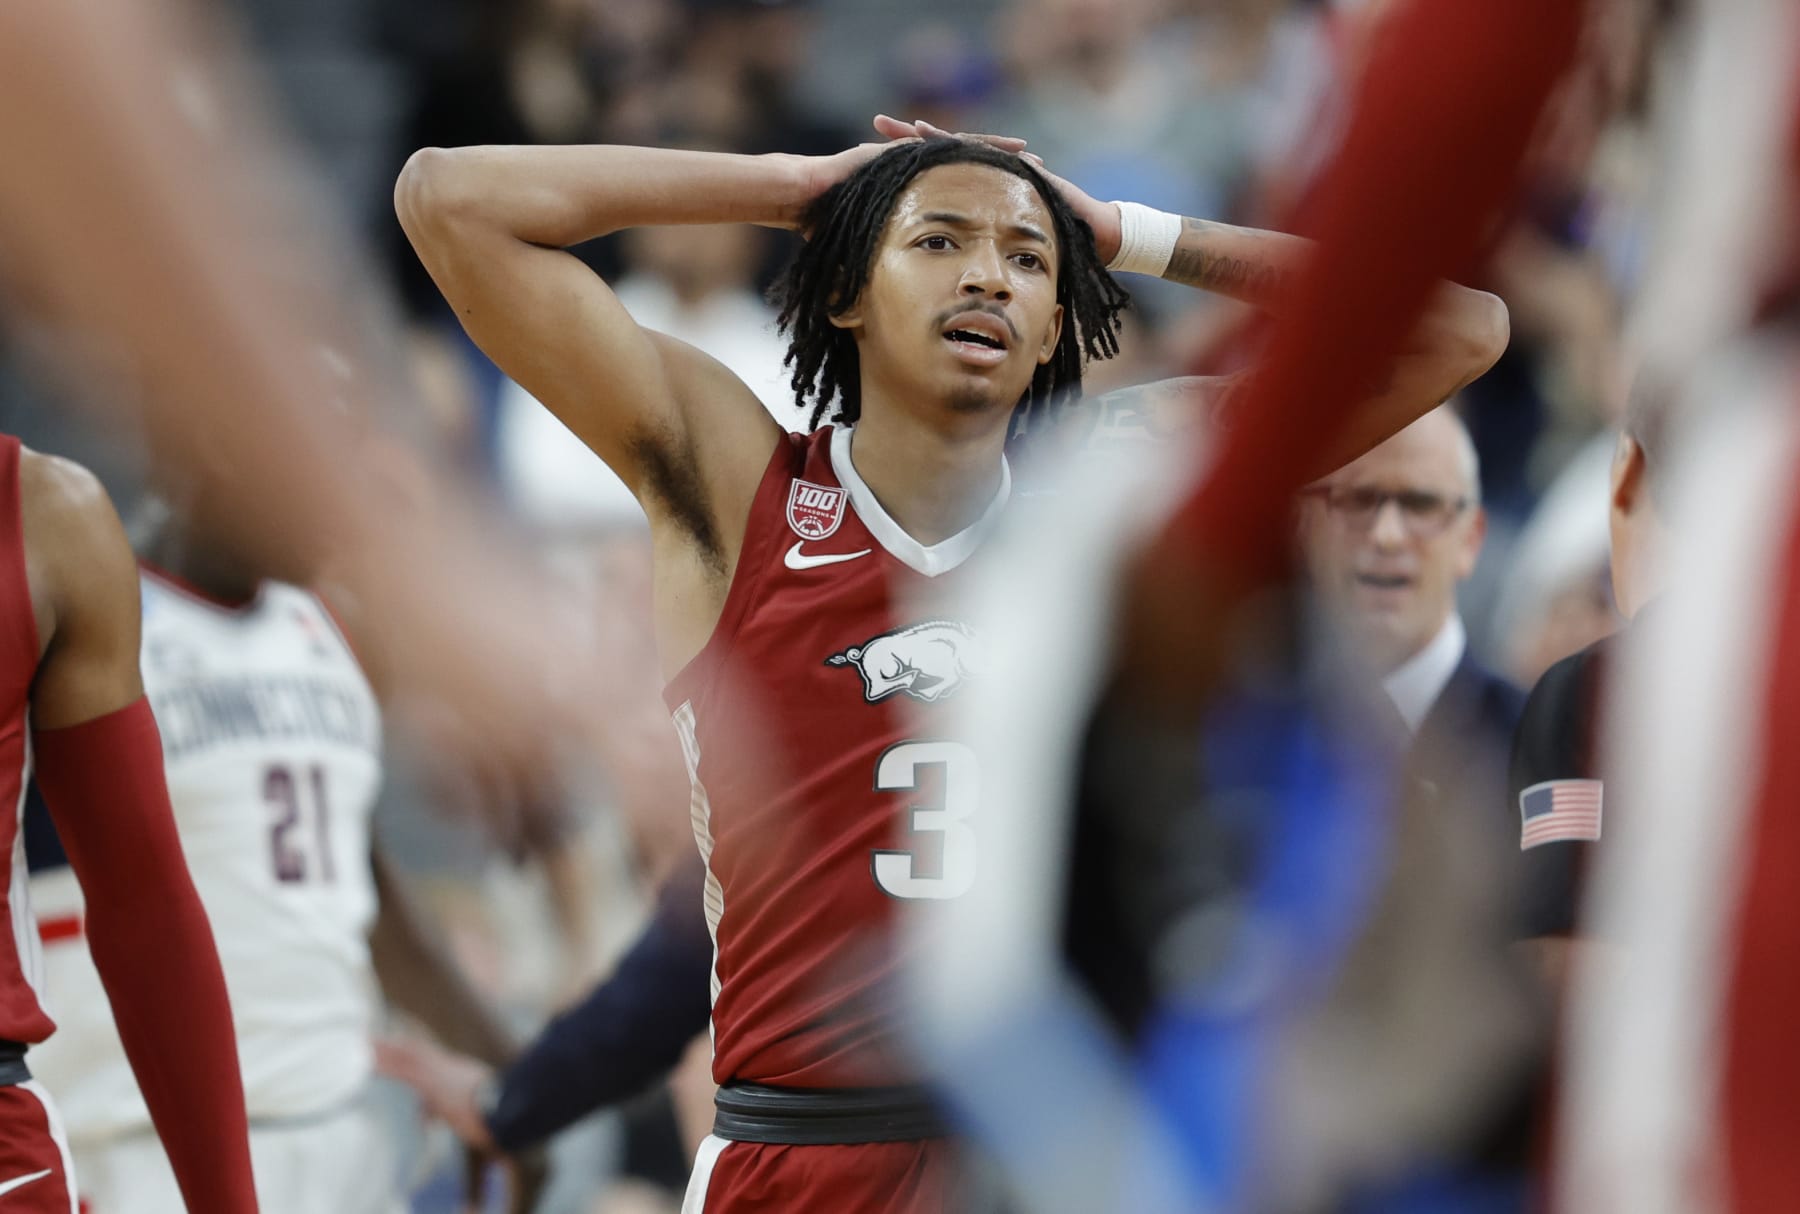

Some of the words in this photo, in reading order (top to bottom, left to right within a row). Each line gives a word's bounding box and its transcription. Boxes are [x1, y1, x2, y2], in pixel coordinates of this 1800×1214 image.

[797, 487, 838, 510] 100
[264, 765, 336, 883] 21
[871, 738, 980, 901] 3
